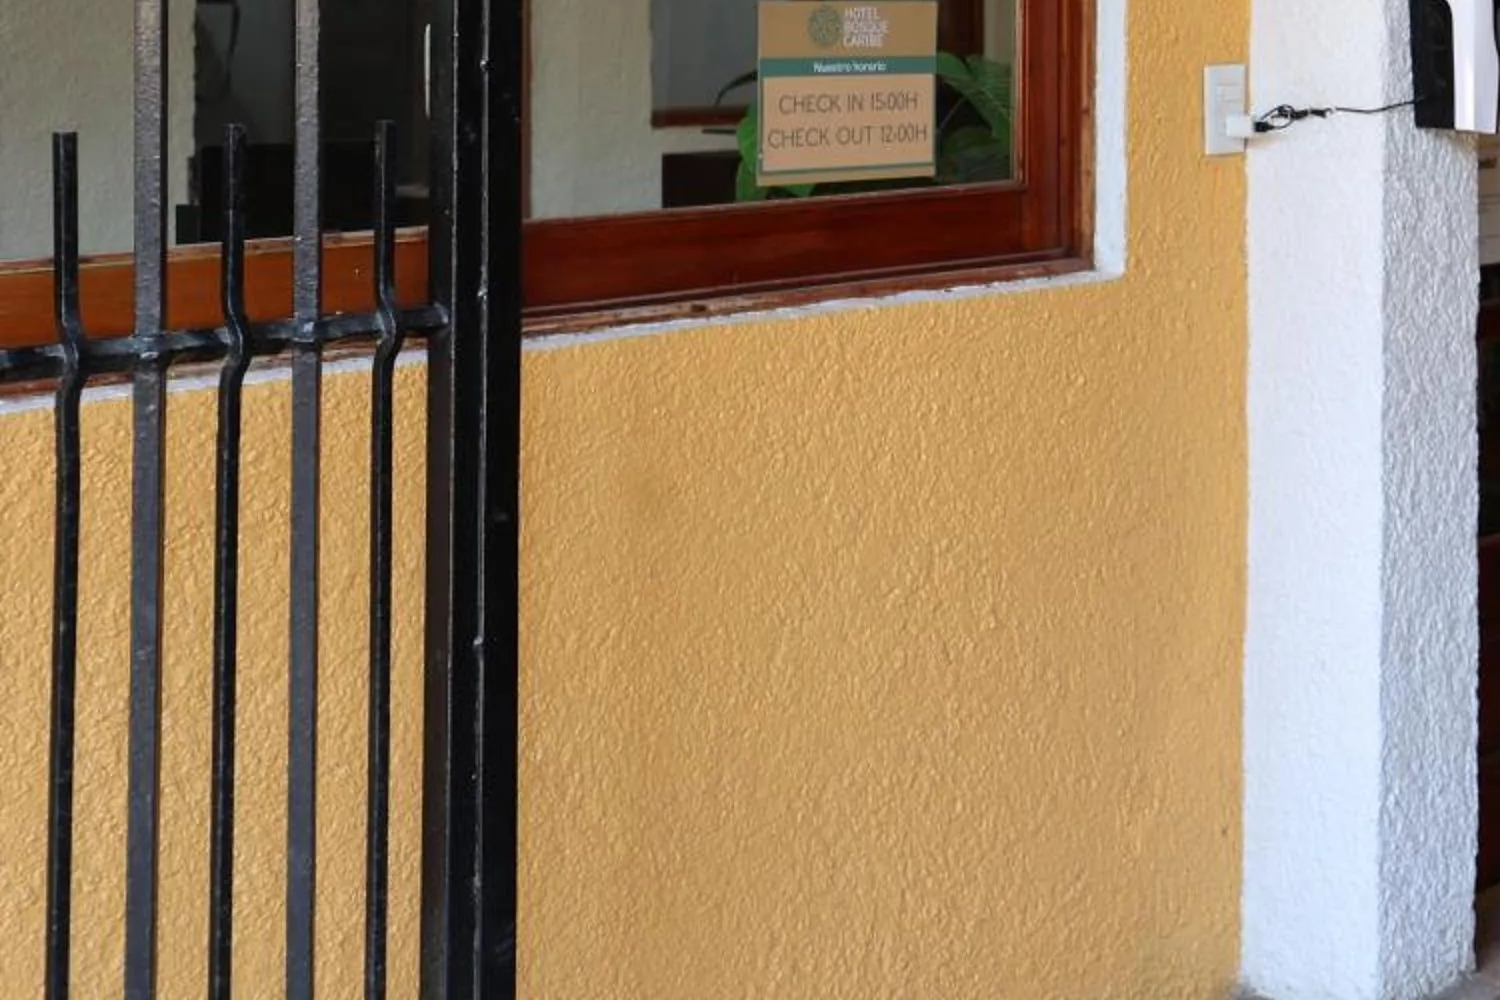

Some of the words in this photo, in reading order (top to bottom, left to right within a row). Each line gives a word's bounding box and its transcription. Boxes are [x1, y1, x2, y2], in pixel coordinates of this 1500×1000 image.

[844, 6, 880, 20] HOTEL
[778, 93, 841, 115] CHECK
[847, 93, 864, 112] IN
[767, 127, 830, 150] CHECK
[835, 124, 876, 145] OUT
